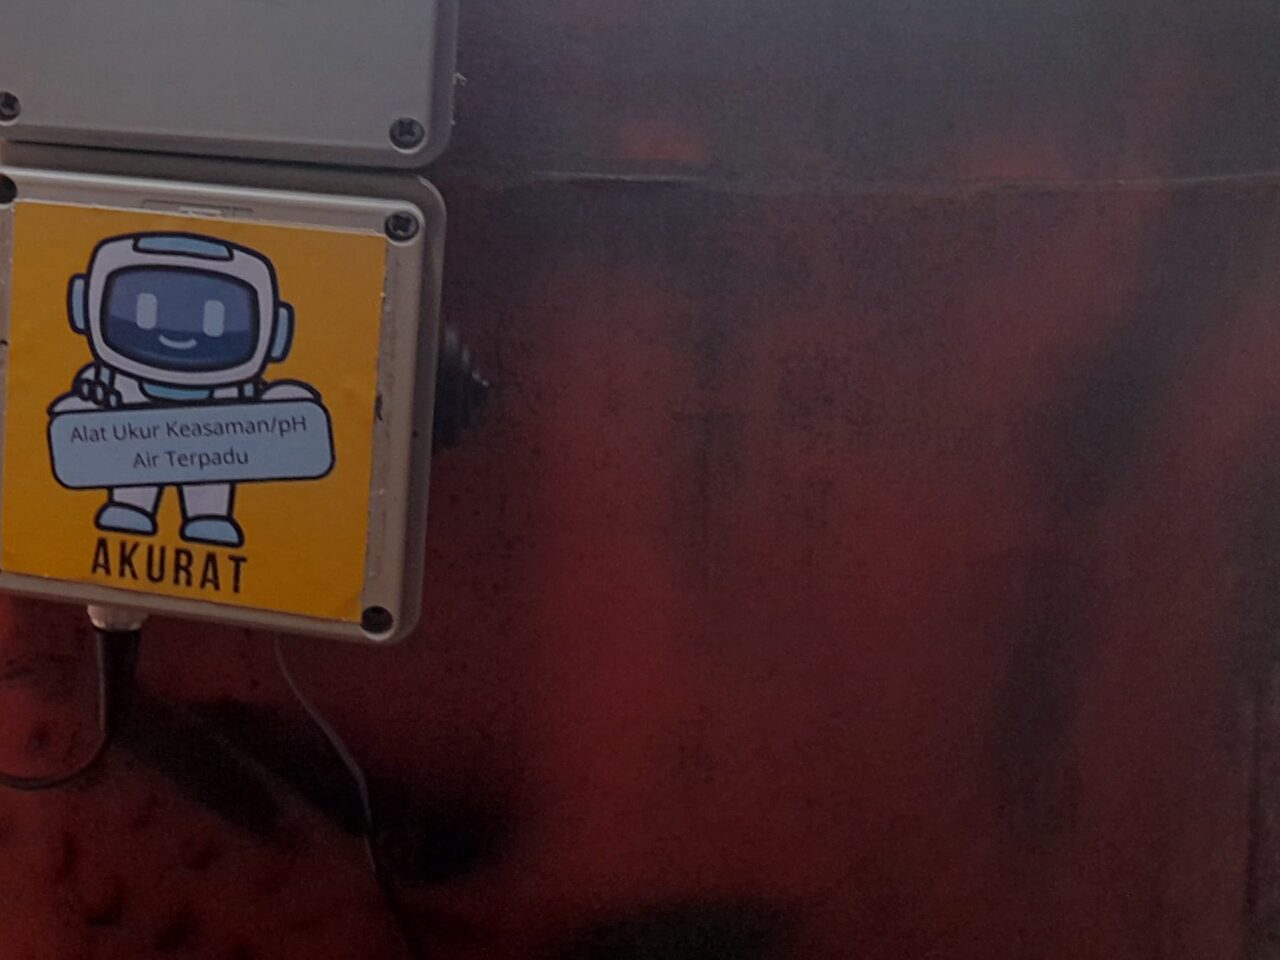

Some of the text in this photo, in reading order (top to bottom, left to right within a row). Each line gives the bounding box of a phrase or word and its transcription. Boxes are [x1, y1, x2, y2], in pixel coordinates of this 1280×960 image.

[70, 415, 307, 444] Alat Ukur Keasaman/pH
[133, 448, 249, 470] Air Terpadu
[91, 537, 248, 594] AKURAT
